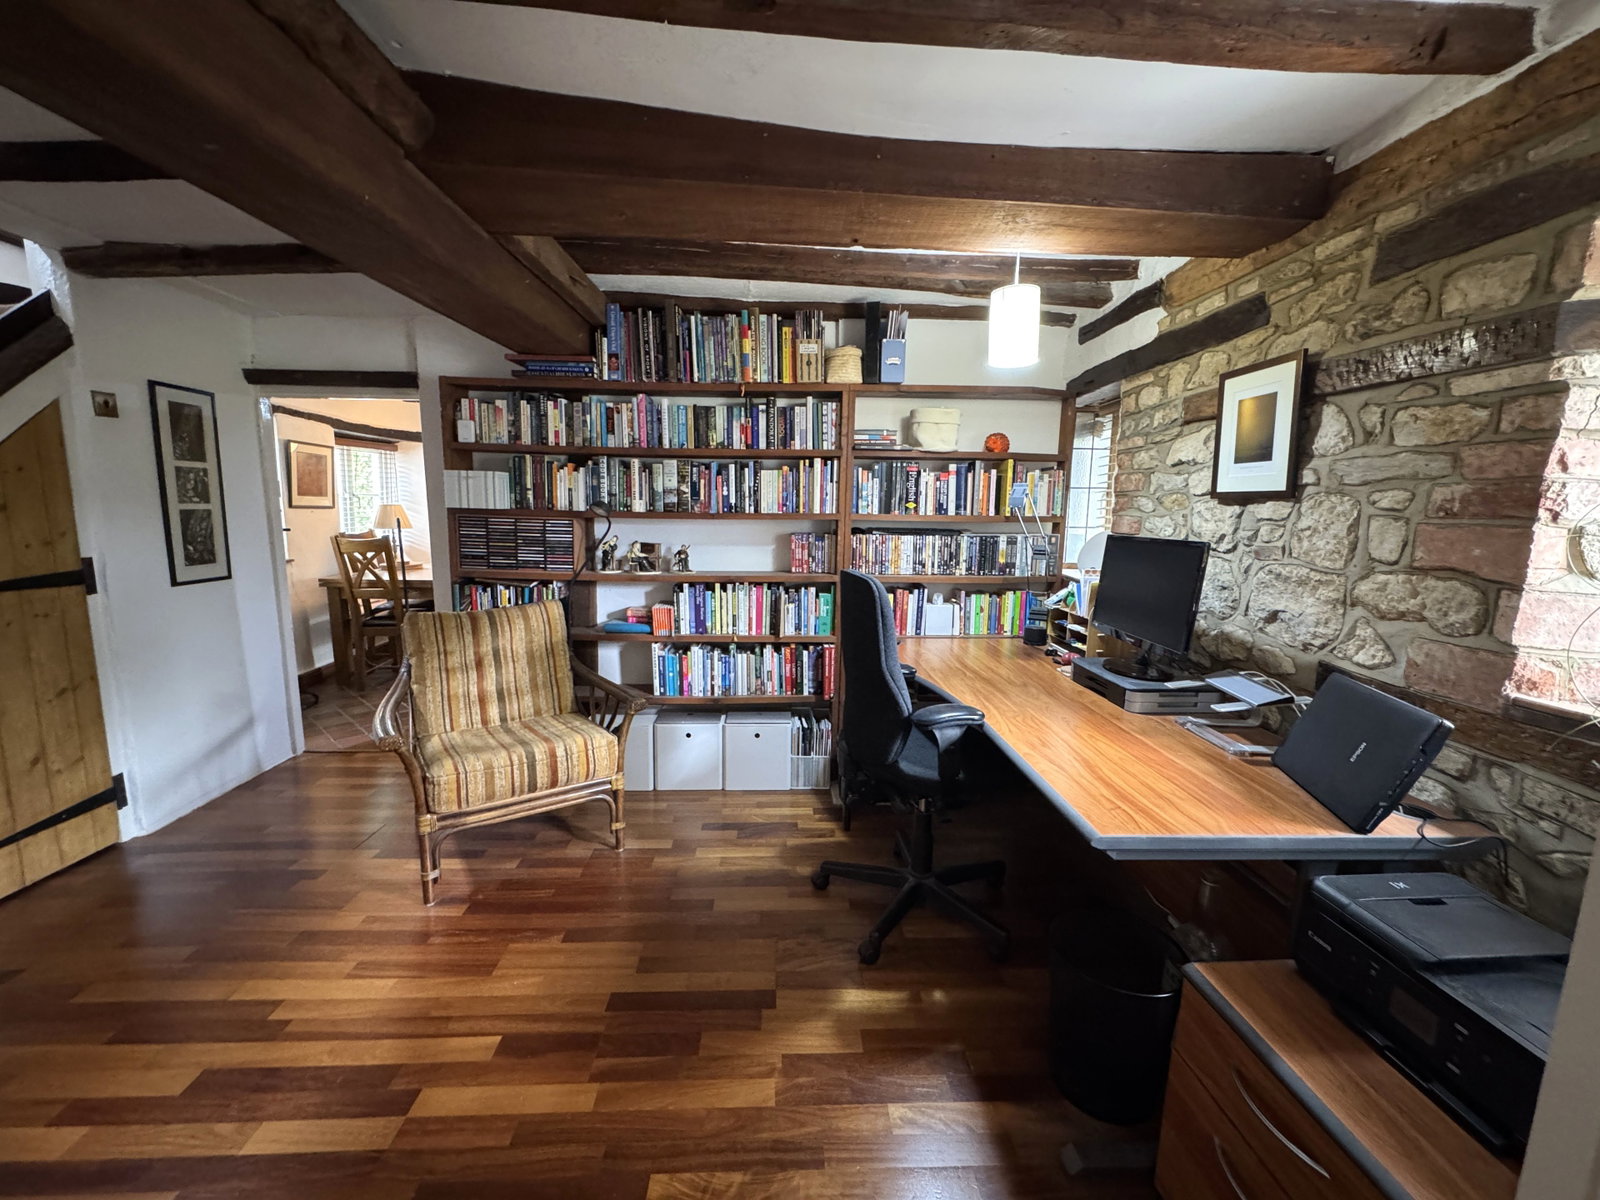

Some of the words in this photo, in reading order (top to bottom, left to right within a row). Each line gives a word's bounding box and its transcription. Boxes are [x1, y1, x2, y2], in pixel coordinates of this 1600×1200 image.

[644, 344, 650, 352] OF
[906, 472, 917, 501] English
[1349, 741, 1367, 762] EPSON
